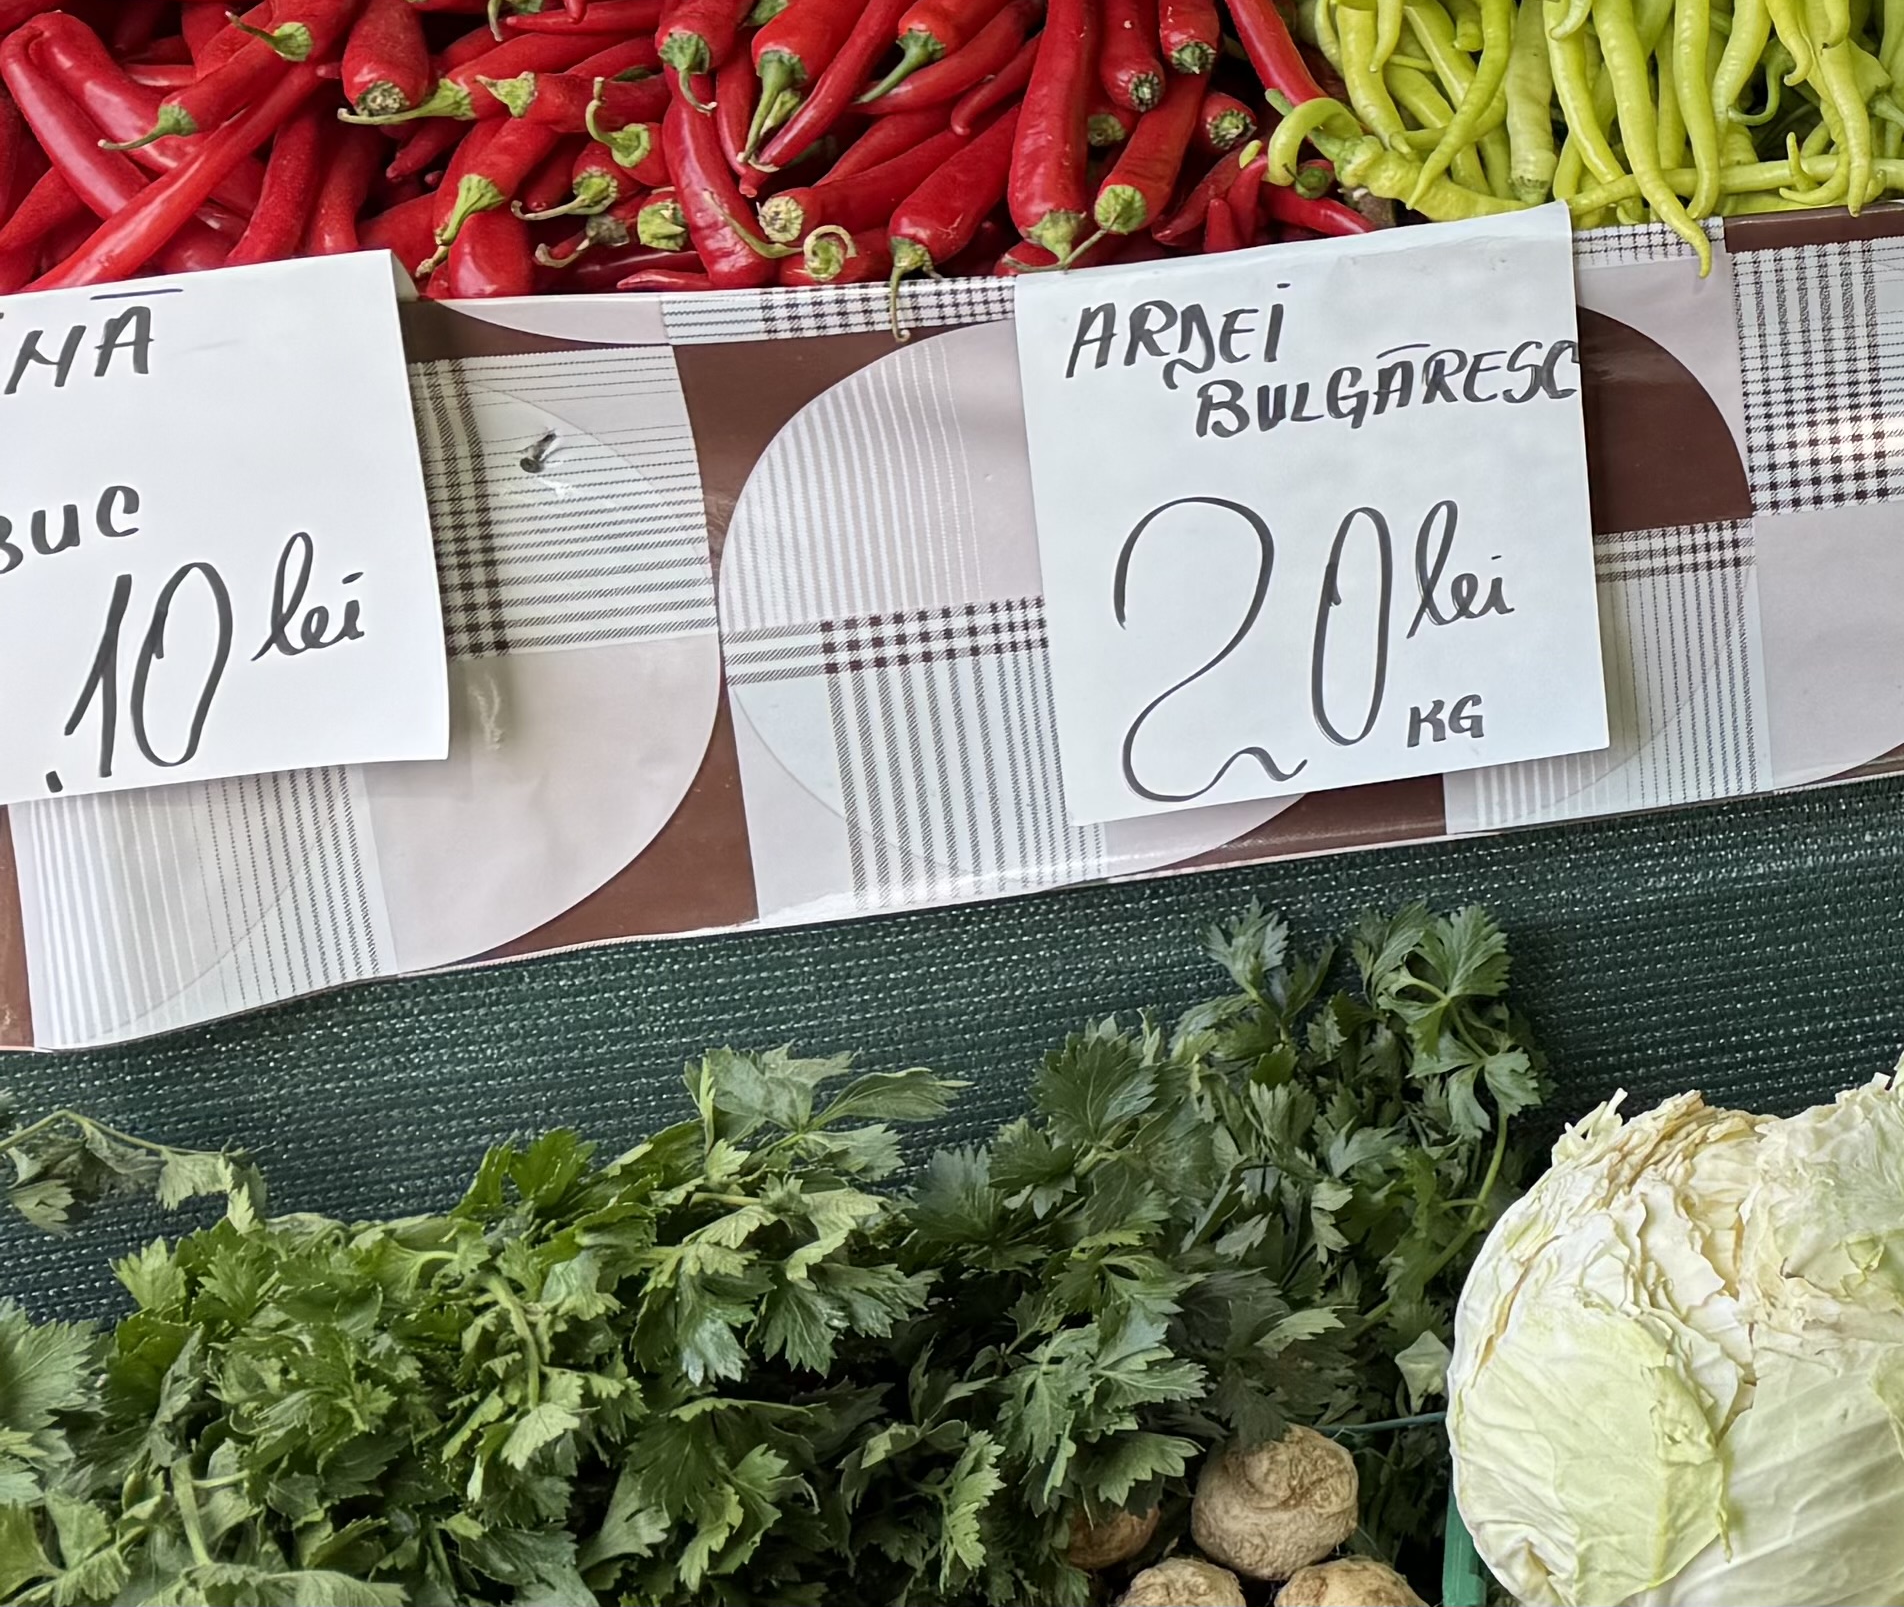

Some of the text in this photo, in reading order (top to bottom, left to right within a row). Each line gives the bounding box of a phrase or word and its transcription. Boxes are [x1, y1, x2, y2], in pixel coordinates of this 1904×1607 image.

[251, 531, 365, 662] lei
[1114, 496, 1515, 802] 20 lei
[1406, 693, 1485, 748] KG
